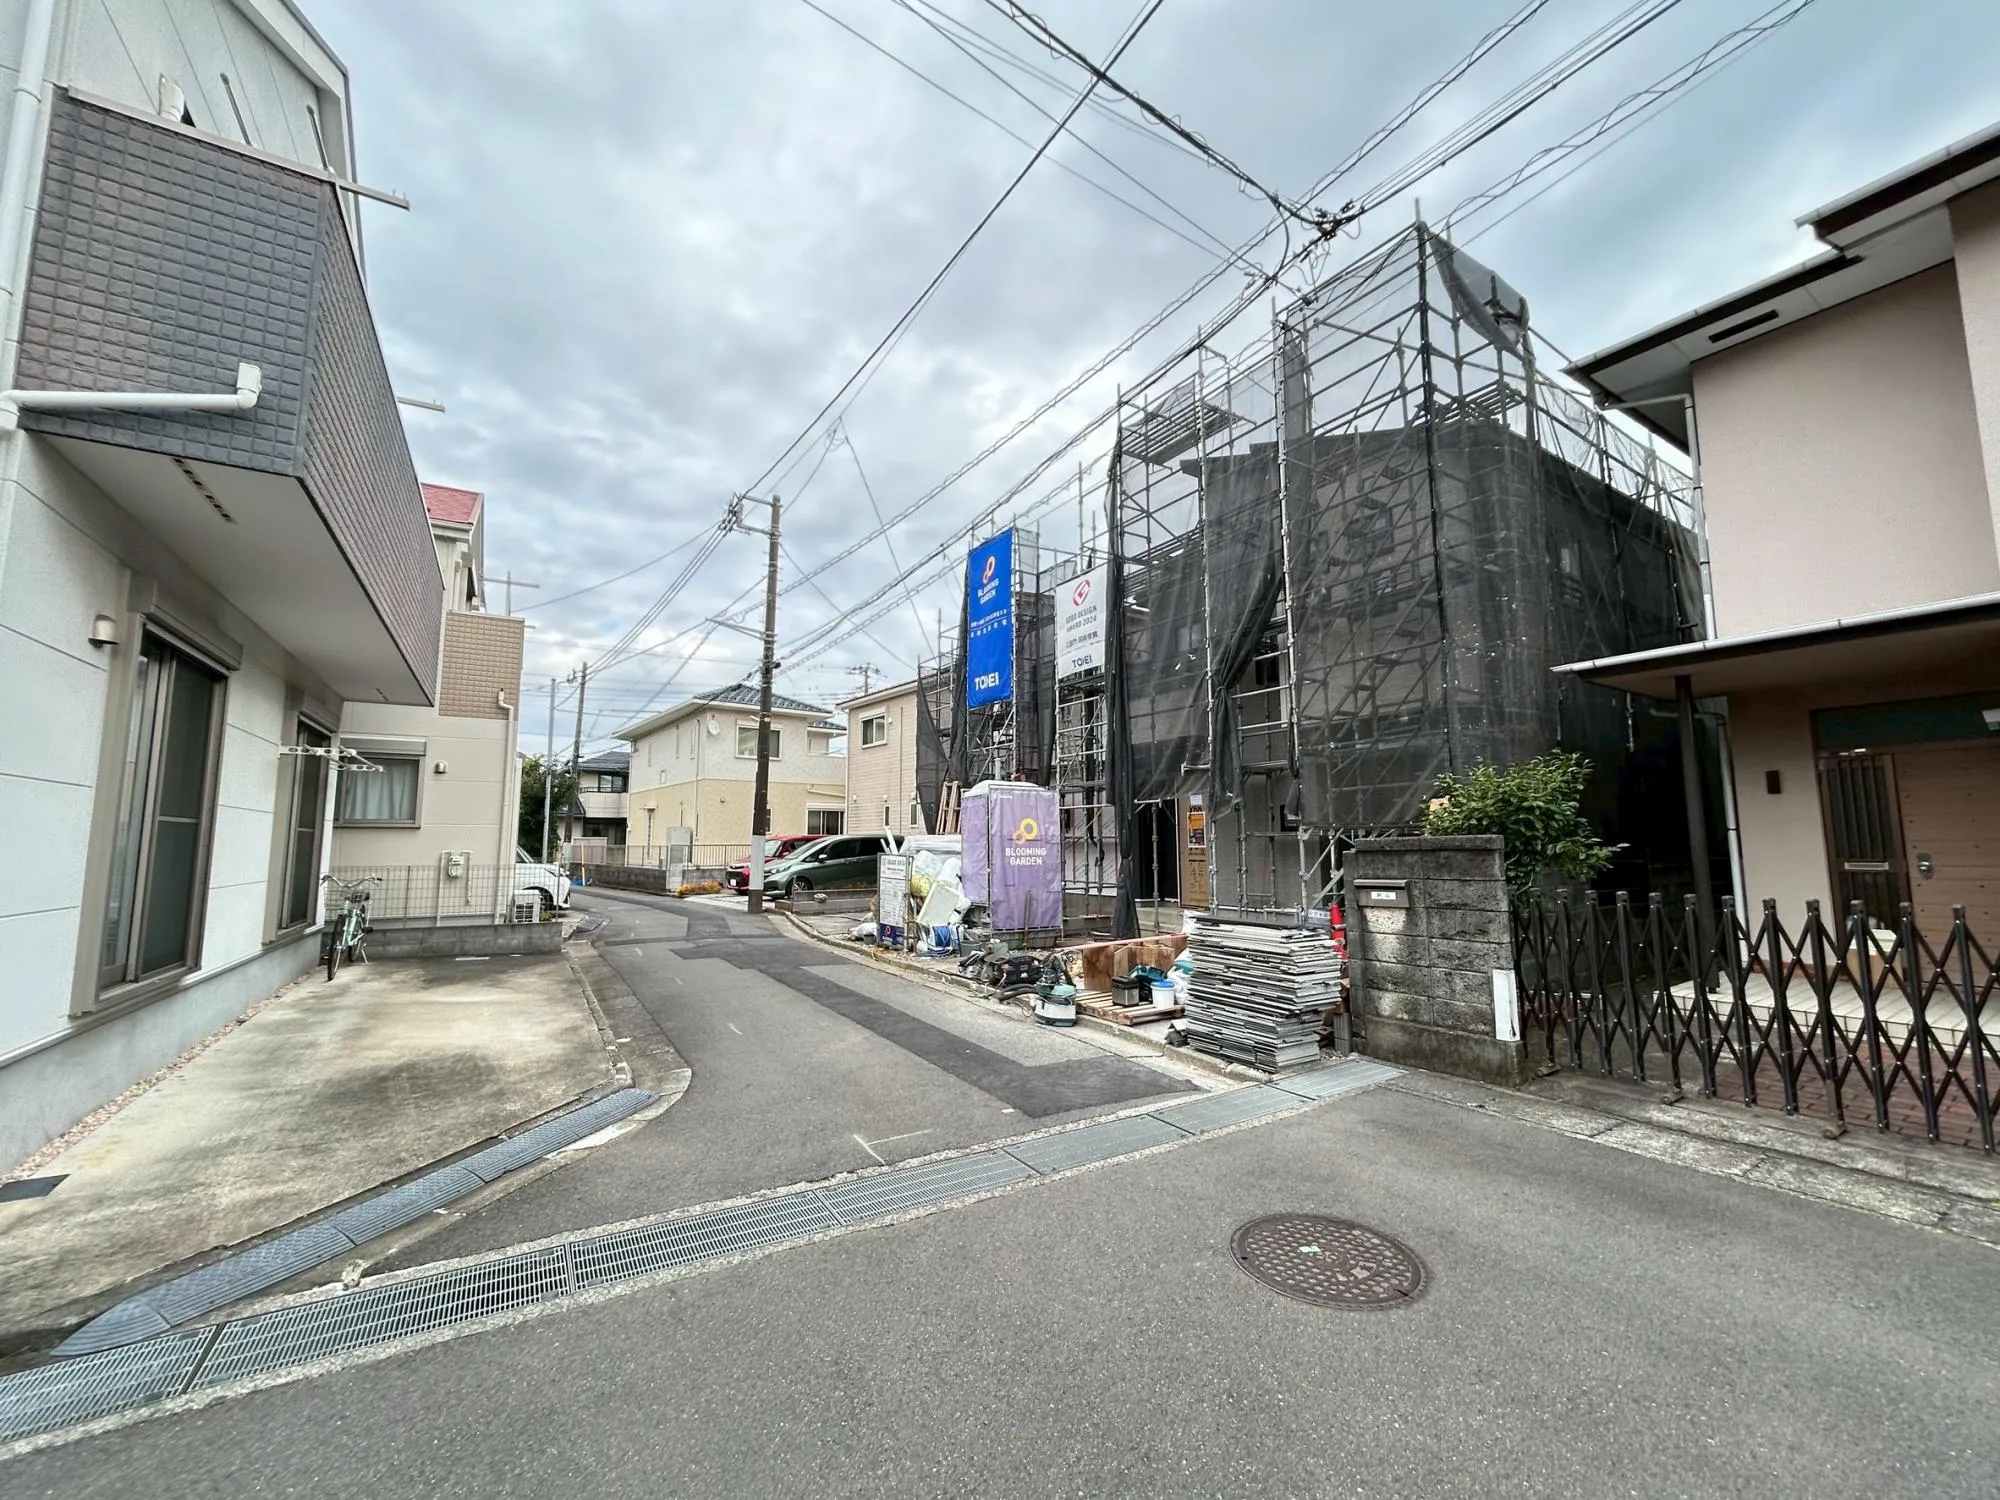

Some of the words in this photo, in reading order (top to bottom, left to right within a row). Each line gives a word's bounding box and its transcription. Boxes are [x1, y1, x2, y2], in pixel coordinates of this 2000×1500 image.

[1077, 604, 1098, 618] DESIGN
[1082, 614, 1097, 627] 2024
[1005, 847, 1047, 857] BLOOMING
[1009, 856, 1043, 866] GARDEN
